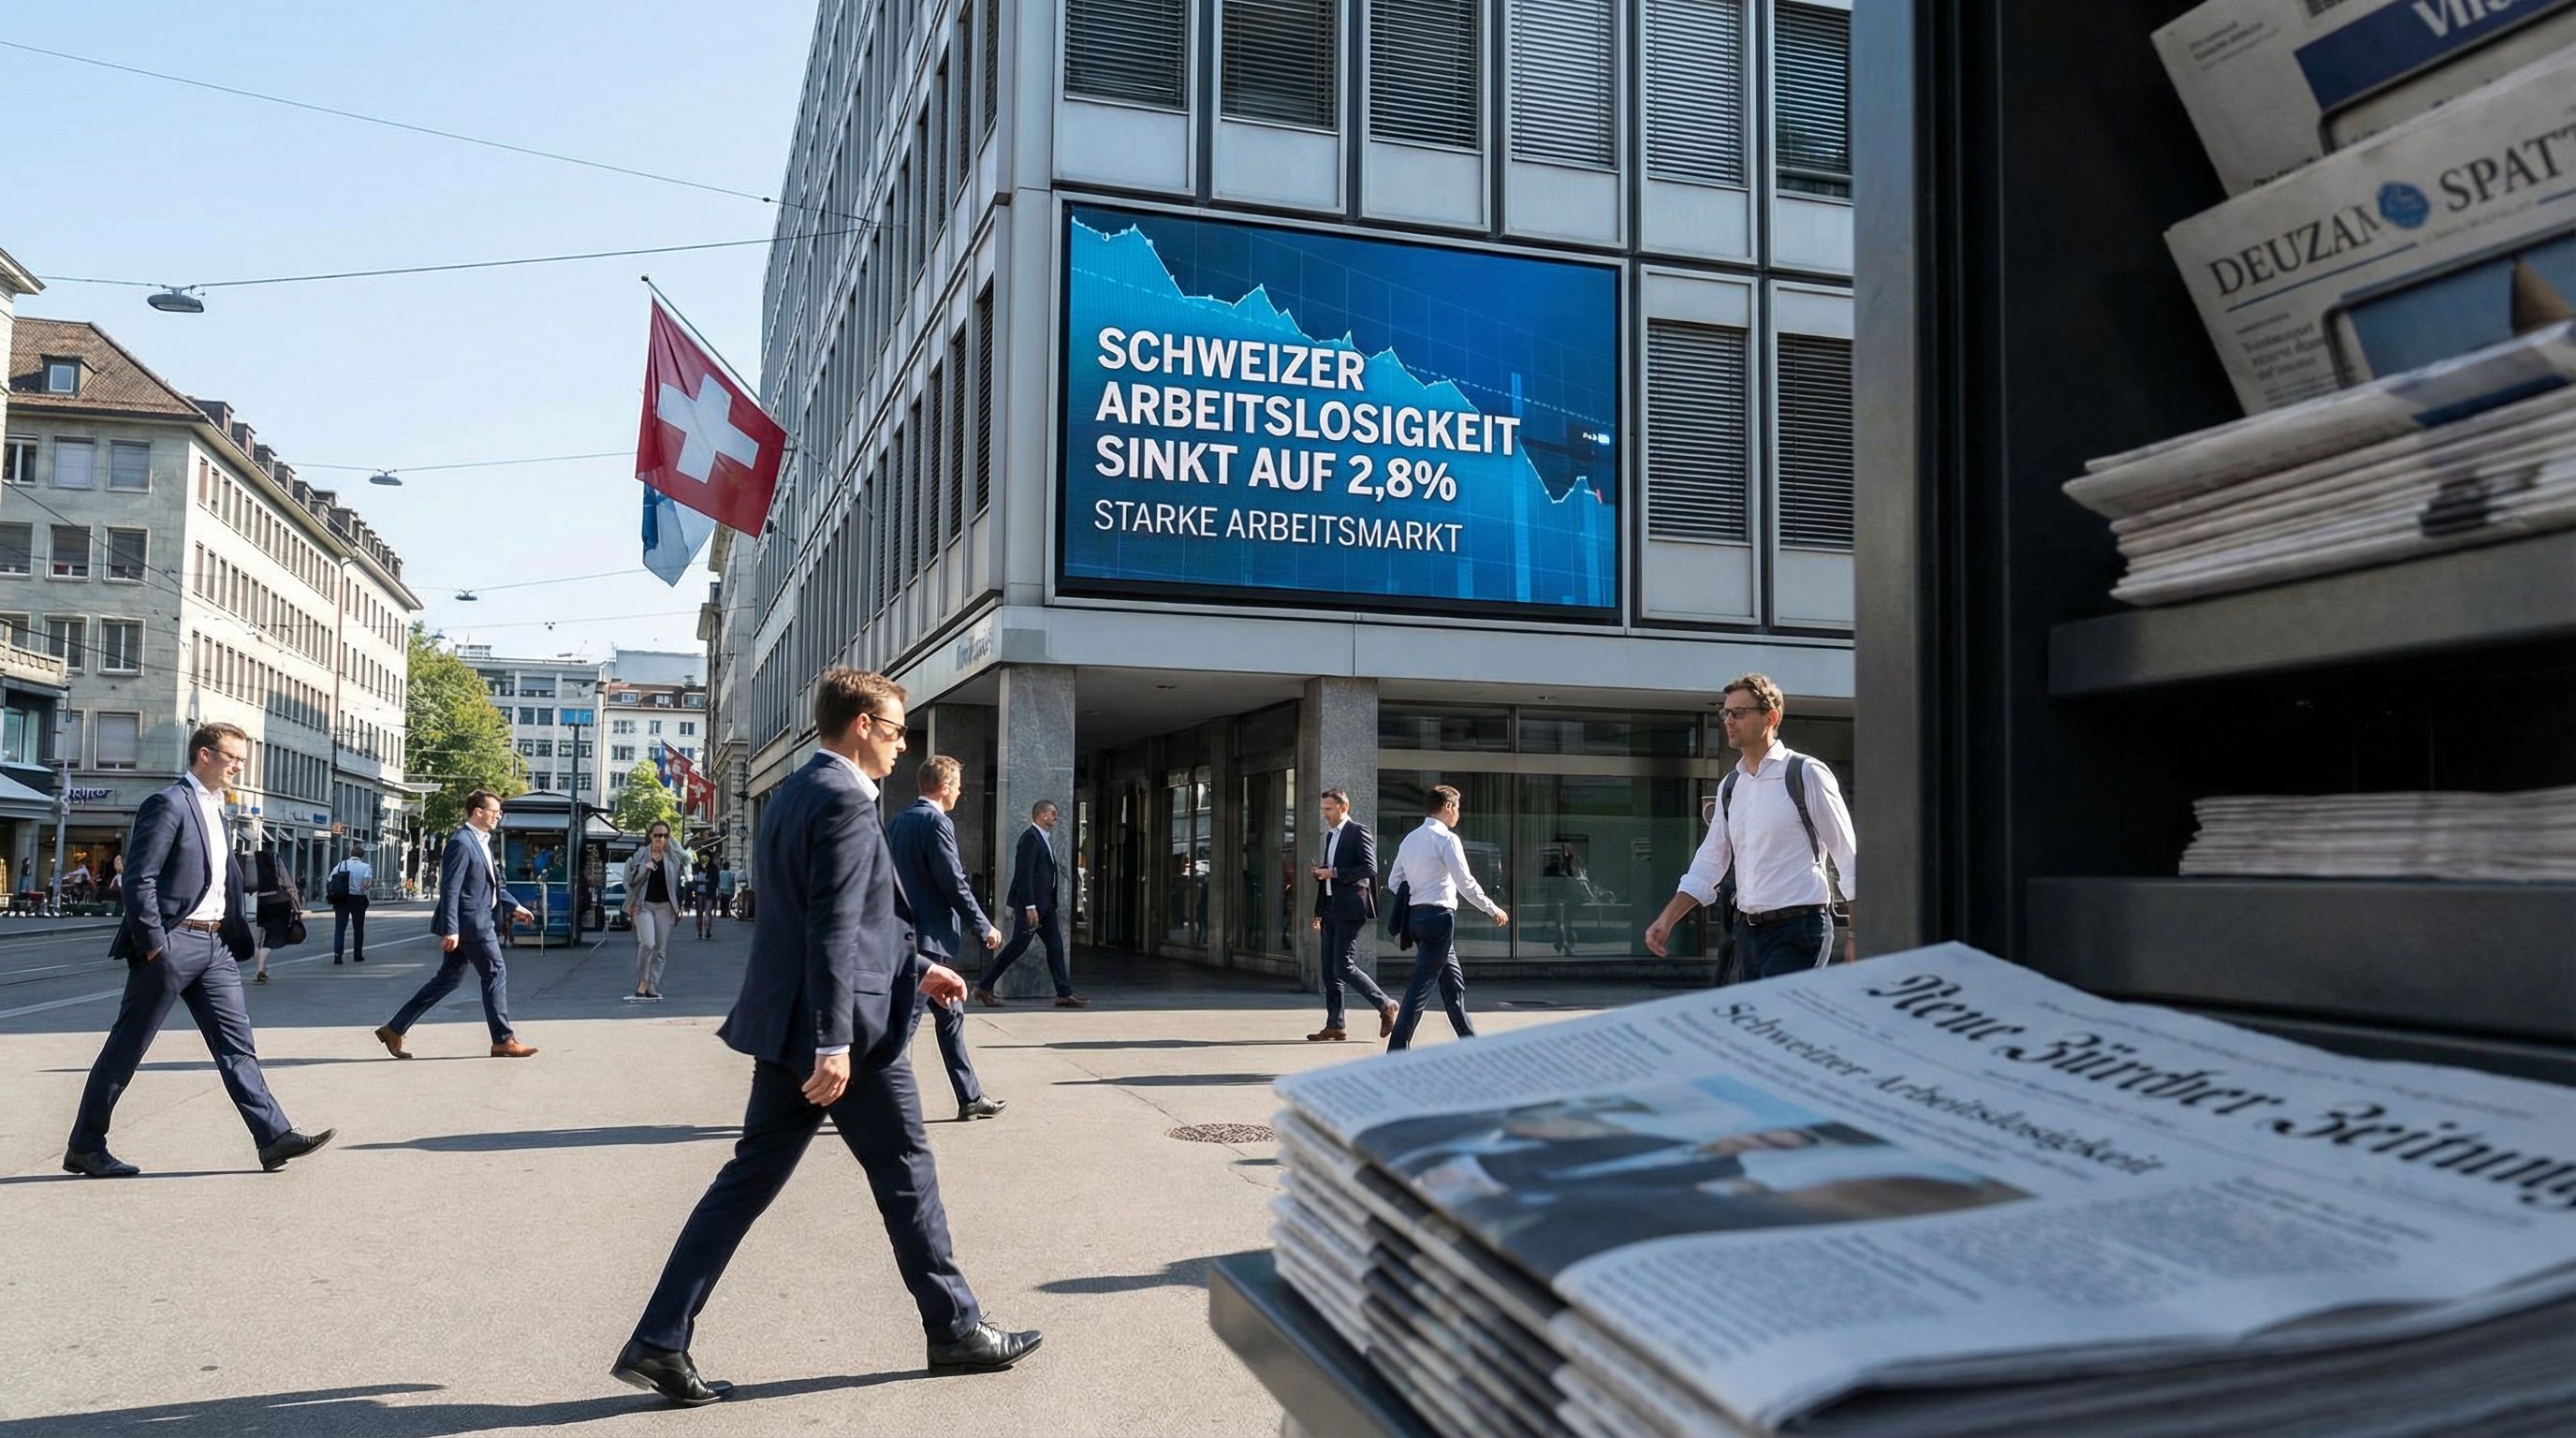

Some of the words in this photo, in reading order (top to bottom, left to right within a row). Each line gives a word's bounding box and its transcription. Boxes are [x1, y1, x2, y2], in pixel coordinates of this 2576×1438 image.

[1096, 326, 1367, 392] SCHWEIZER
[1095, 381, 1521, 457] ARBEITSLOSIGKEIT
[1094, 435, 1238, 484] SINKT
[1249, 448, 1337, 492] AUF
[1347, 456, 1458, 504] 2,8%
[1093, 499, 1219, 538] STARKE
[1225, 508, 1464, 554] ARBEITSMARKT
